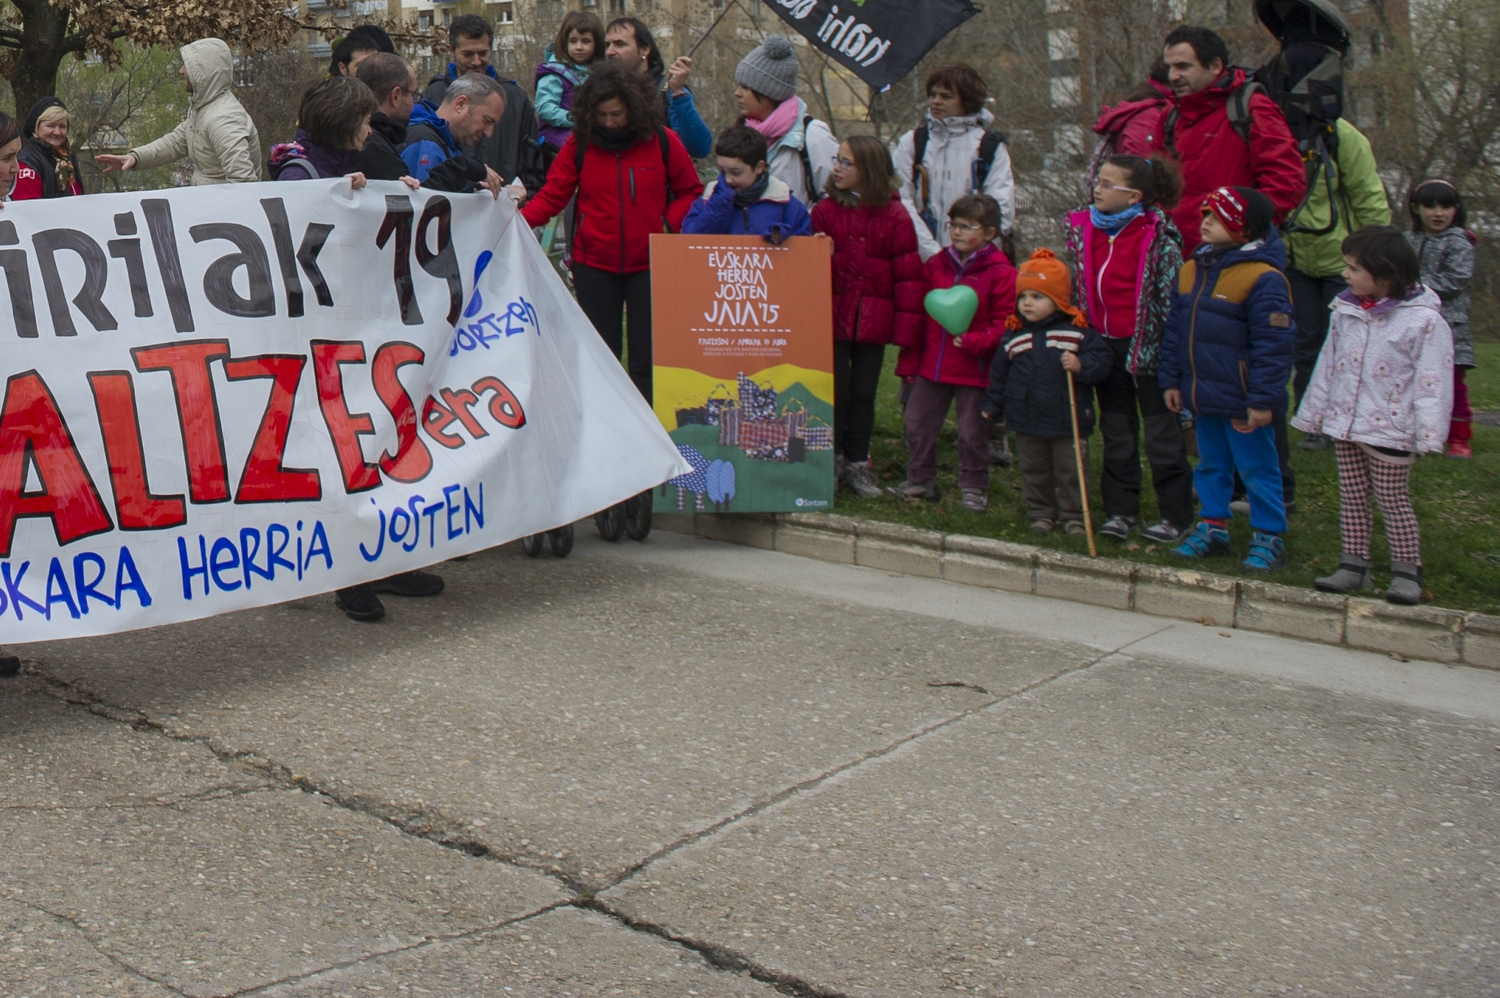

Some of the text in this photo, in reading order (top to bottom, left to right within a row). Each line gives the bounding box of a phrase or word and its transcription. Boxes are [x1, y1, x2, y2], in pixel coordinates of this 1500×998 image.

[375, 195, 464, 329] 19
[708, 251, 774, 270] EUSKARA
[717, 269, 765, 285] HERRIA
[714, 283, 768, 301] JOSTEN
